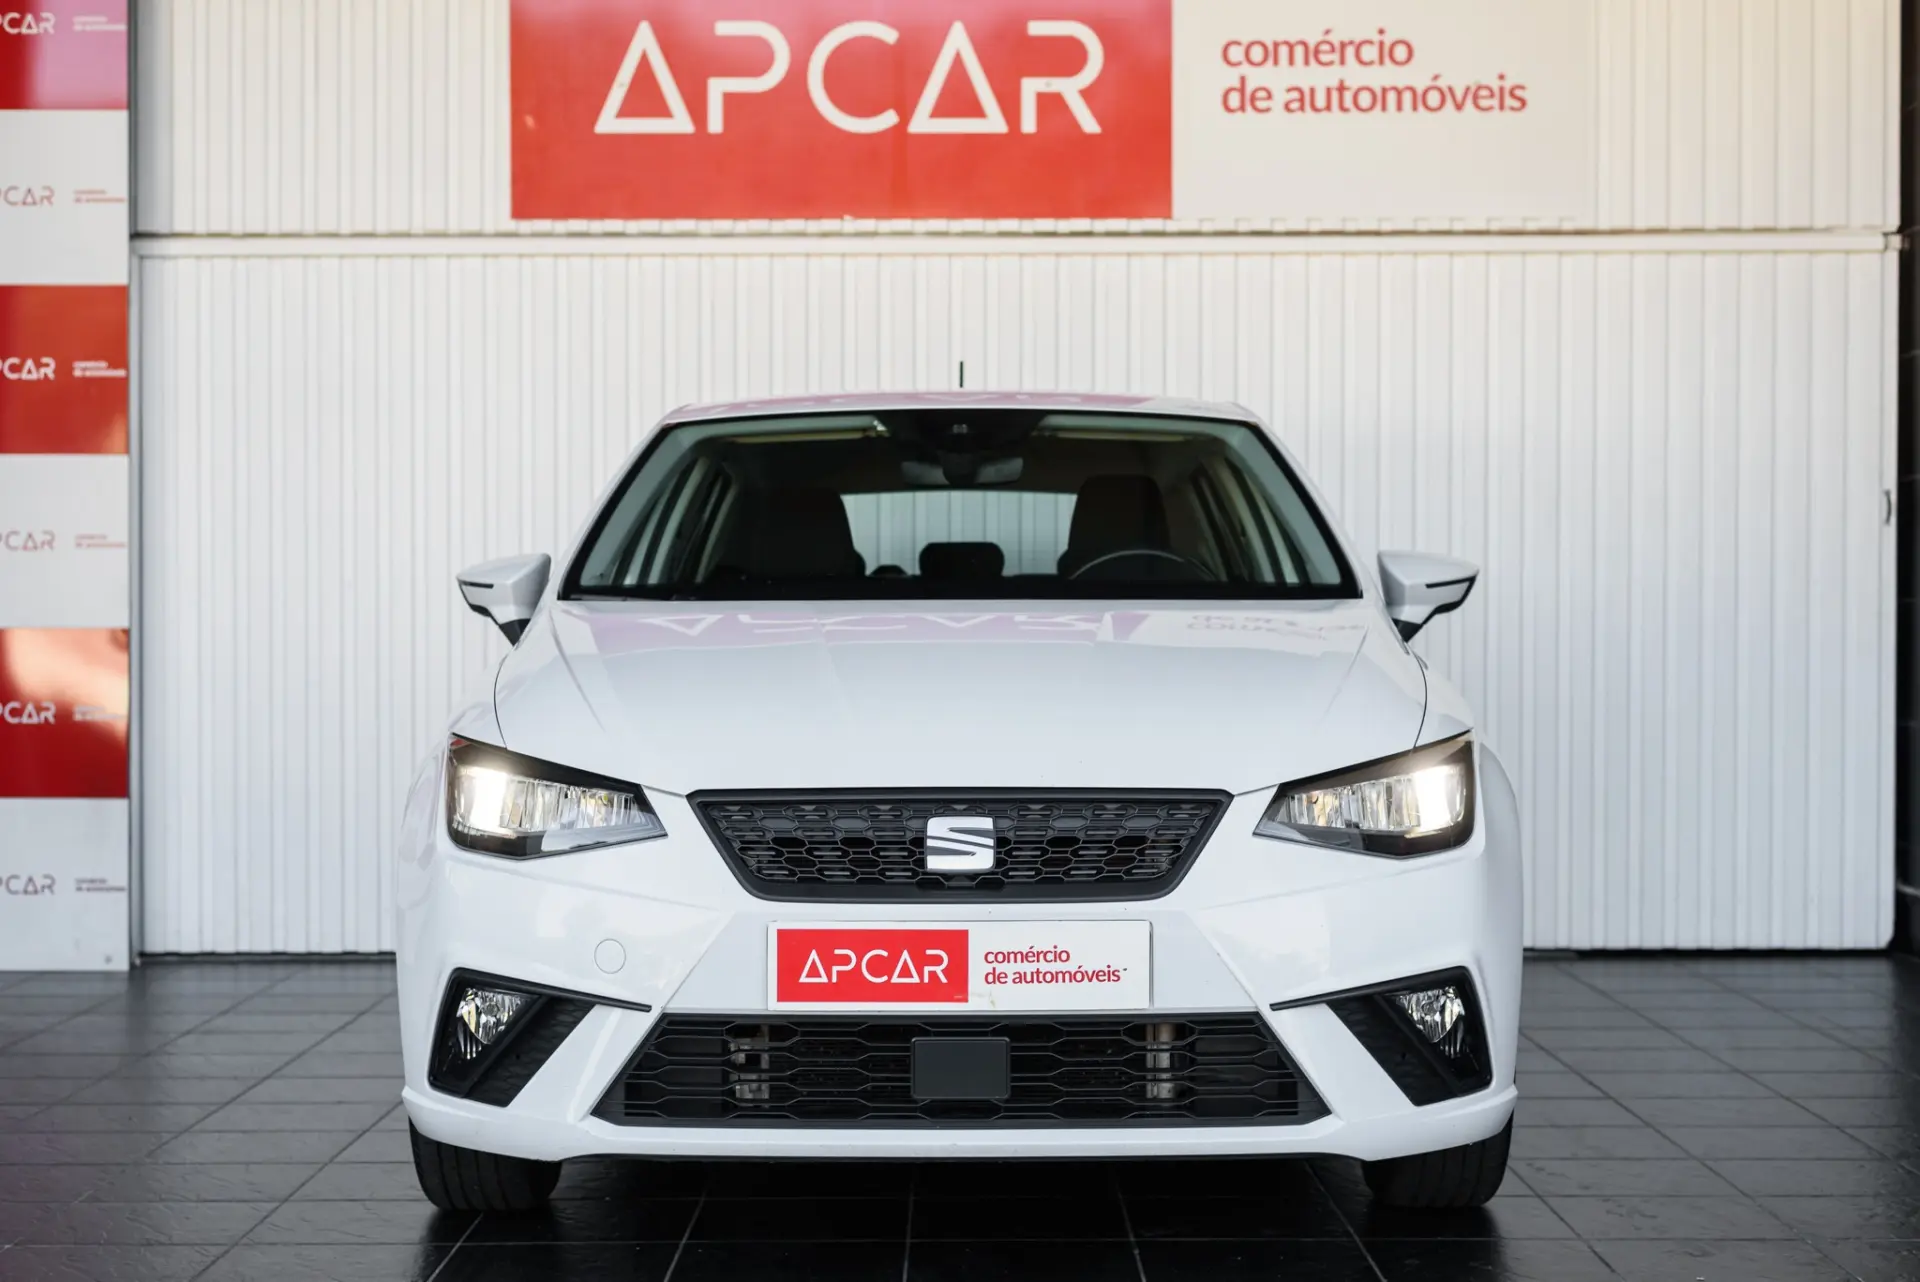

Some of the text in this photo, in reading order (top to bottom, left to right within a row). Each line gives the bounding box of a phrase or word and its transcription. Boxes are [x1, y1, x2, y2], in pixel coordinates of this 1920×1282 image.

[0, 11, 56, 35] CAR
[1221, 27, 1414, 68] comércio
[594, 18, 1104, 135] APCAR
[1221, 72, 1528, 114] de automóveis
[0, 185, 55, 207] CAR
[0, 356, 56, 381] CAR
[0, 529, 56, 552] CAR
[0, 700, 56, 725] CAR
[0, 874, 56, 896] CAR
[798, 948, 949, 984] APCAR
[983, 944, 1071, 965] comércio
[984, 964, 1121, 985] de automóveis
